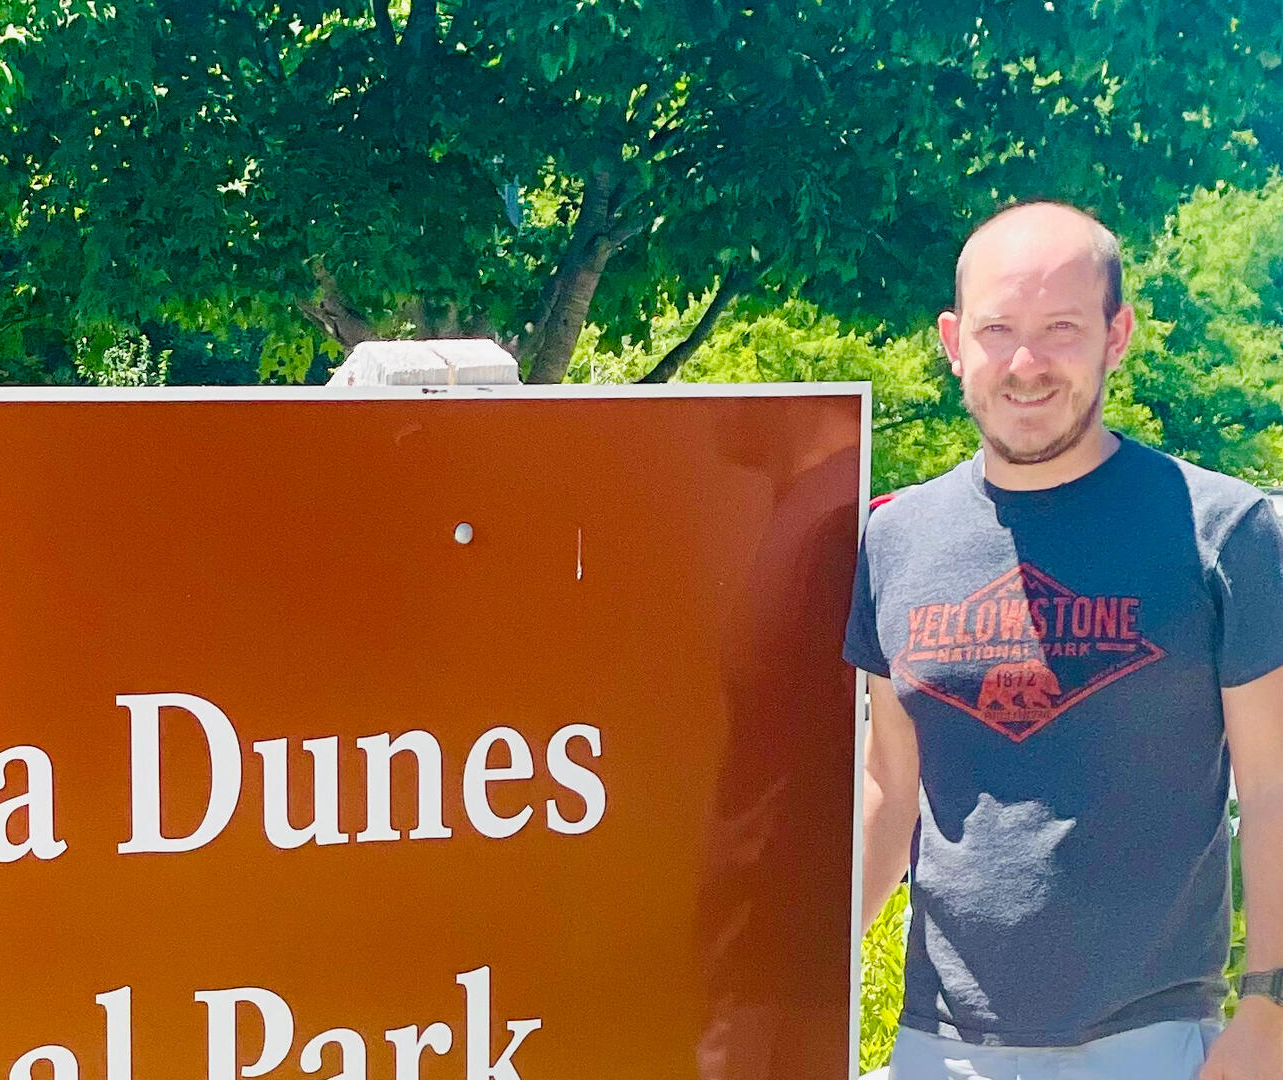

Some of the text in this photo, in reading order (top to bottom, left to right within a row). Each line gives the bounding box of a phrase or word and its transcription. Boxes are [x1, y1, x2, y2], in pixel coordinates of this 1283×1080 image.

[908, 596, 1140, 649] YELLOWSTONE
[937, 641, 1091, 662] NATIONAL PARK
[996, 670, 1036, 688] 1872
[114, 692, 608, 857] Dunes
